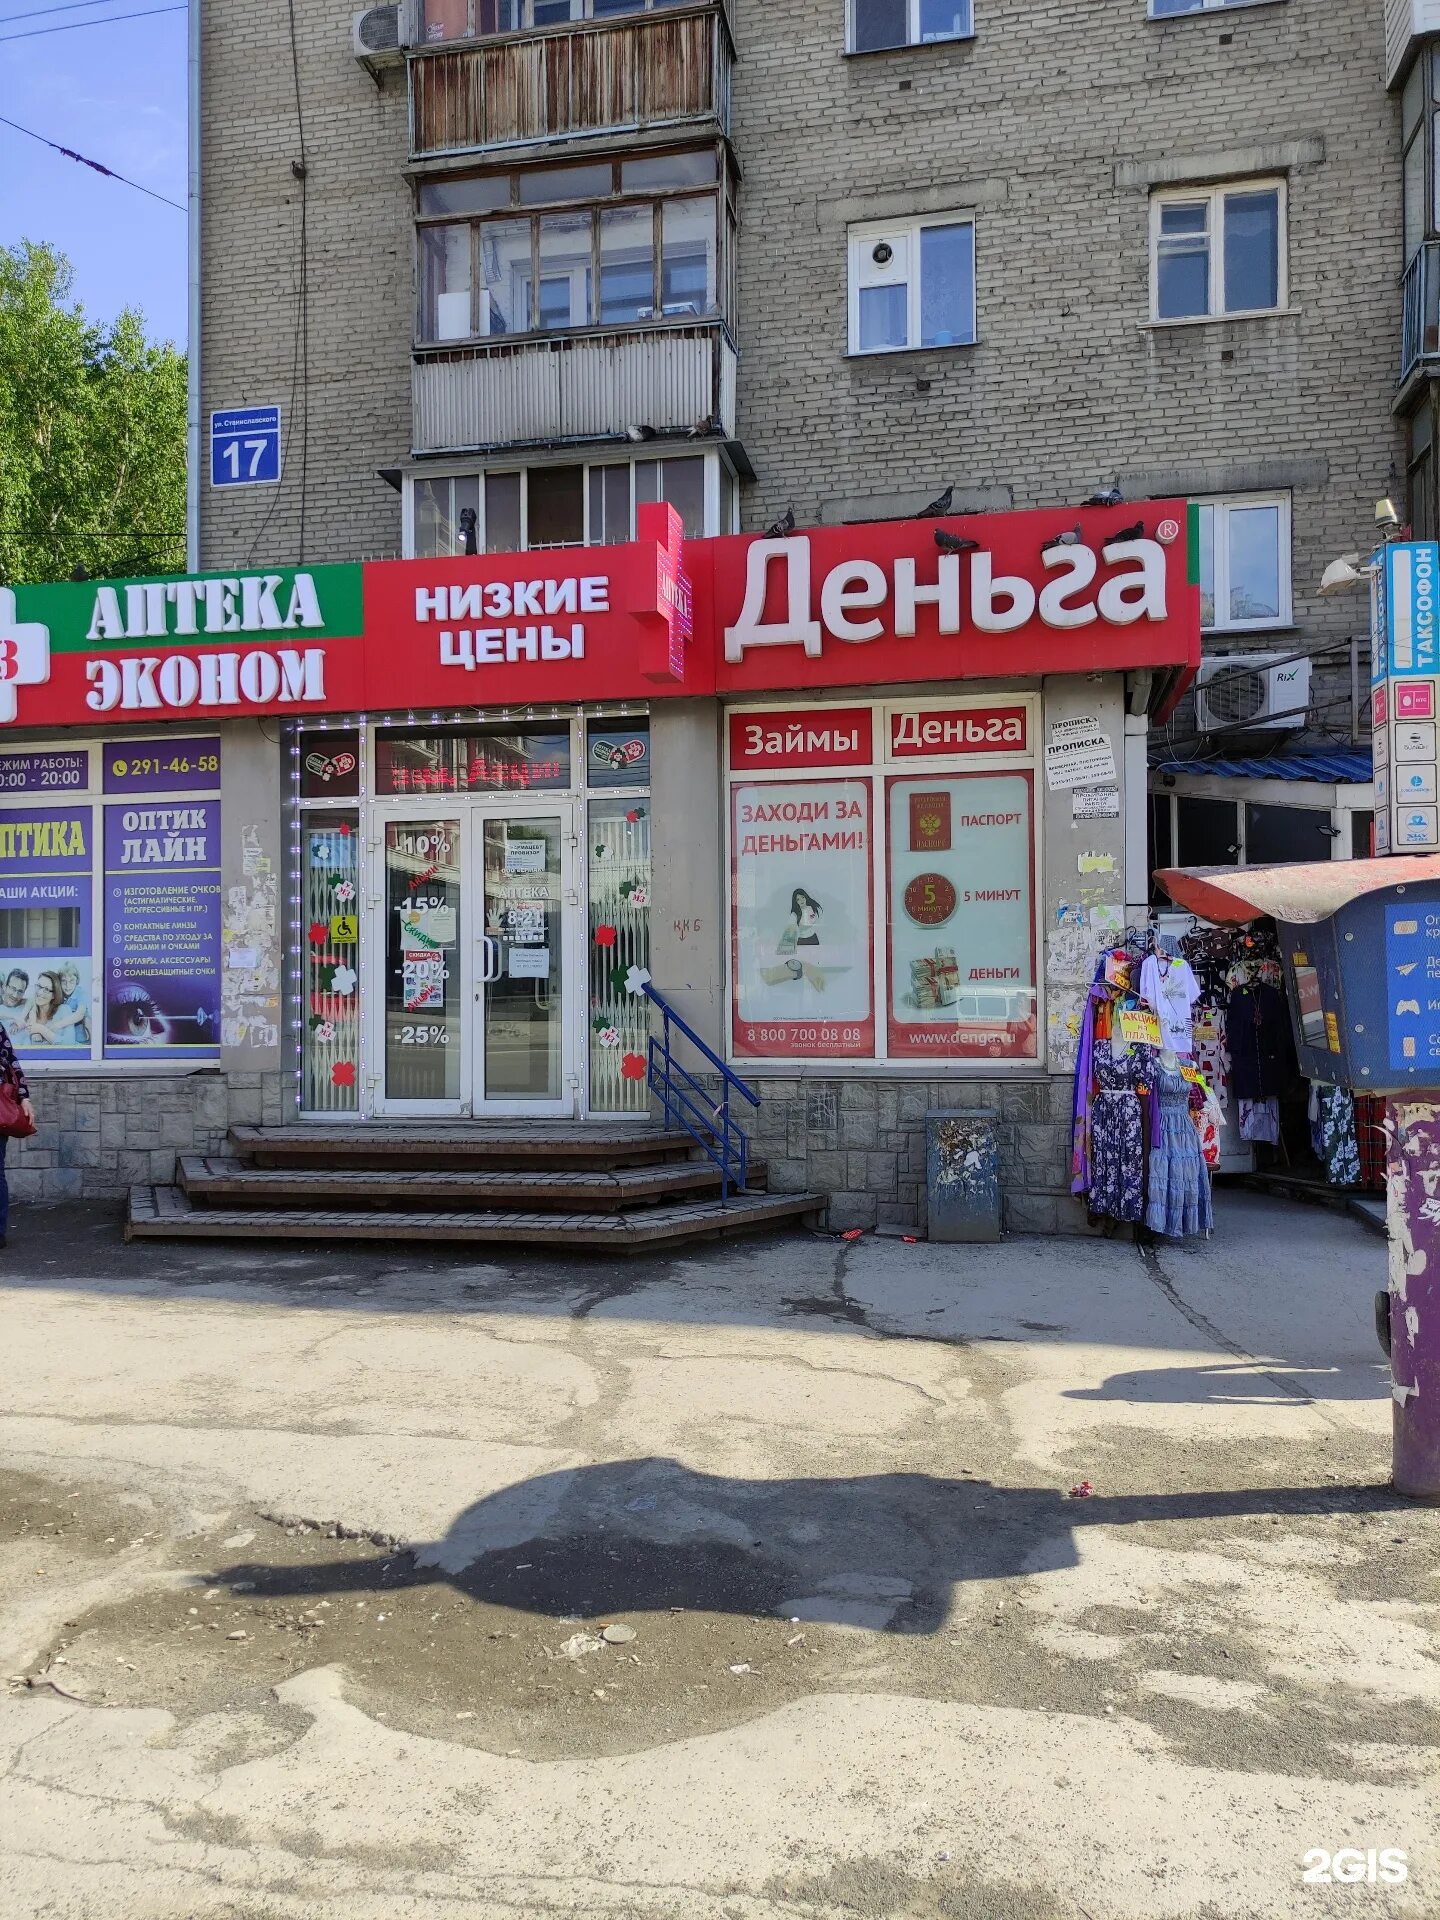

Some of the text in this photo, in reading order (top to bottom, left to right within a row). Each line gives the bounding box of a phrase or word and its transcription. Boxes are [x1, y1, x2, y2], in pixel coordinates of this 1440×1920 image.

[224, 416, 277, 427] Станиславского
[223, 439, 268, 479] 17
[85, 573, 326, 641] АПТЕКА
[415, 575, 610, 622] НИЗКИЕ
[724, 535, 1168, 663] Деньга
[1415, 548, 1434, 668] ТАКСОФОН
[439, 623, 585, 672] ЦЕНЫ
[85, 648, 326, 712] ЭКОНОМ
[744, 724, 859, 755] Займы
[893, 713, 1023, 749] Деньга
[1047, 737, 1105, 755] ПРОПИСКА
[34, 757, 83, 769] РАБОТЫ:
[131, 755, 219, 776] 291-46-58
[41, 770, 80, 785] 20:00
[122, 808, 207, 832] ОПТИК
[741, 800, 862, 823] ЗАХОДИ ЗА
[961, 813, 1022, 828] ПАСПОРТ
[121, 831, 207, 864] ЛАЙН
[396, 835, 450, 855] -10%
[741, 831, 864, 856] ДЕНЬГАМИ!
[31, 885, 79, 899] АКЦИИ:
[124, 885, 220, 896] ИЗГОТОВЛЕНИЕ ОЧКОВ
[499, 886, 549, 899] АПТЕКА
[924, 884, 936, 905] 5
[963, 889, 1022, 902] 5 МИНУТ
[124, 905, 185, 914] ПРОГРЕССИВНЫЕ
[193, 904, 208, 914] ПР.)
[394, 896, 449, 915] -15%
[124, 921, 197, 931] КОНТАКТНЫЕ ЛИНЗЫ
[507, 910, 542, 925] 8-21
[123, 942, 200, 951] ЛИНЗАМИ И ОЧКАМИ
[124, 934, 161, 943] СРЕДСТВА
[162, 933, 174, 941] ПО
[176, 933, 201, 942] УХОДУ
[160, 956, 211, 965] АКСЕССУАРЫ
[124, 967, 216, 977] СОЛНЦЕЗАЩИТНЫЕ ОЧКИ
[394, 961, 450, 979] -20%
[967, 967, 1020, 981] ДЕНЬГИ
[394, 1025, 450, 1044] -25%
[747, 1027, 860, 1041] 8 800 700 08 08
